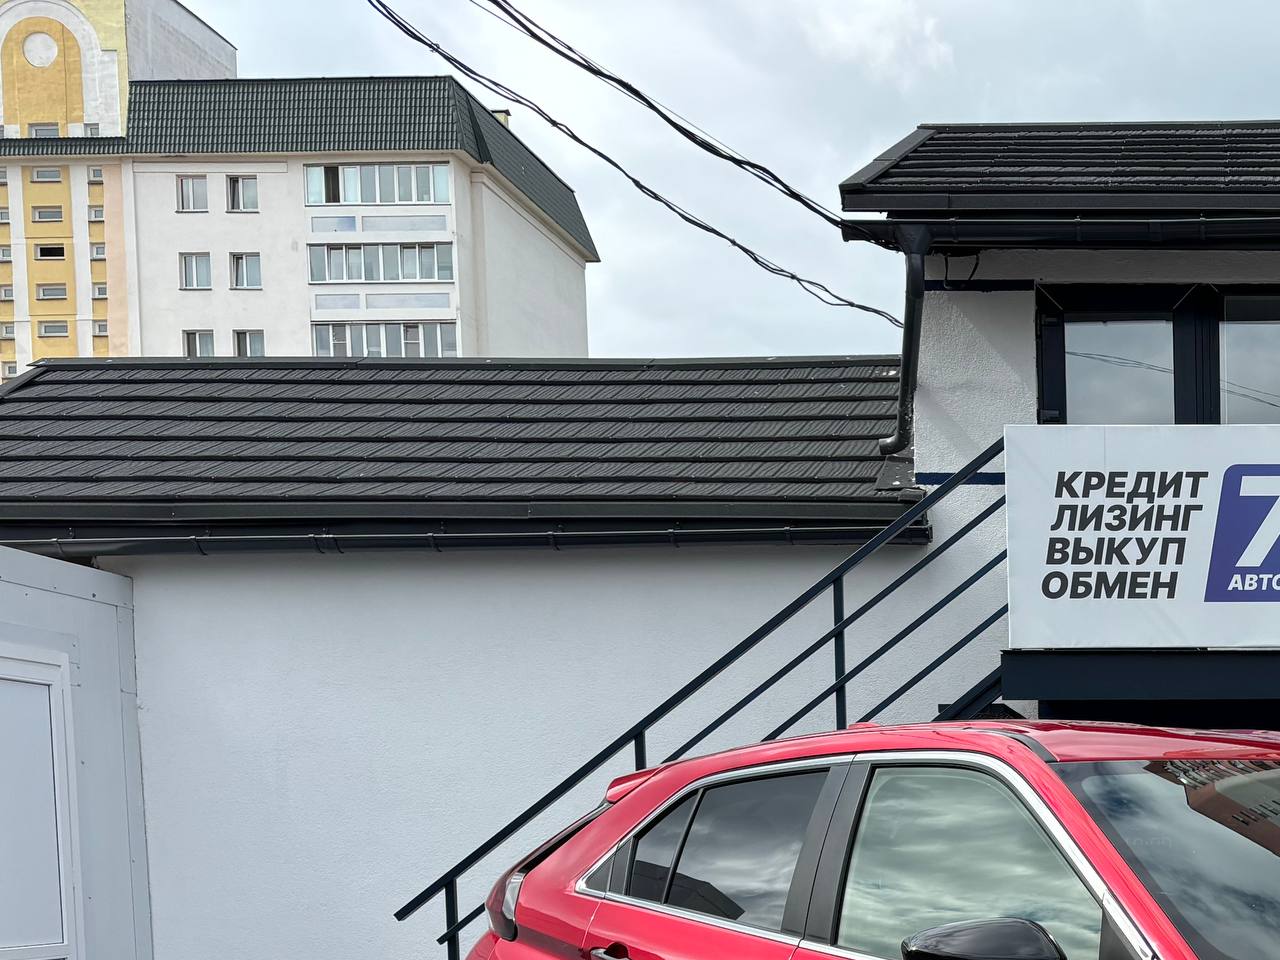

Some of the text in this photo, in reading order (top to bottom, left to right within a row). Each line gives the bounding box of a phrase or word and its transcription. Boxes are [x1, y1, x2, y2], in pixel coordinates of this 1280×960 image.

[1055, 471, 1208, 502] КРЕДИТ
[1050, 504, 1203, 532] ЛИЗИНГ
[1045, 536, 1186, 566] ВЫКУП
[1041, 570, 1179, 600] ОБМЕН
